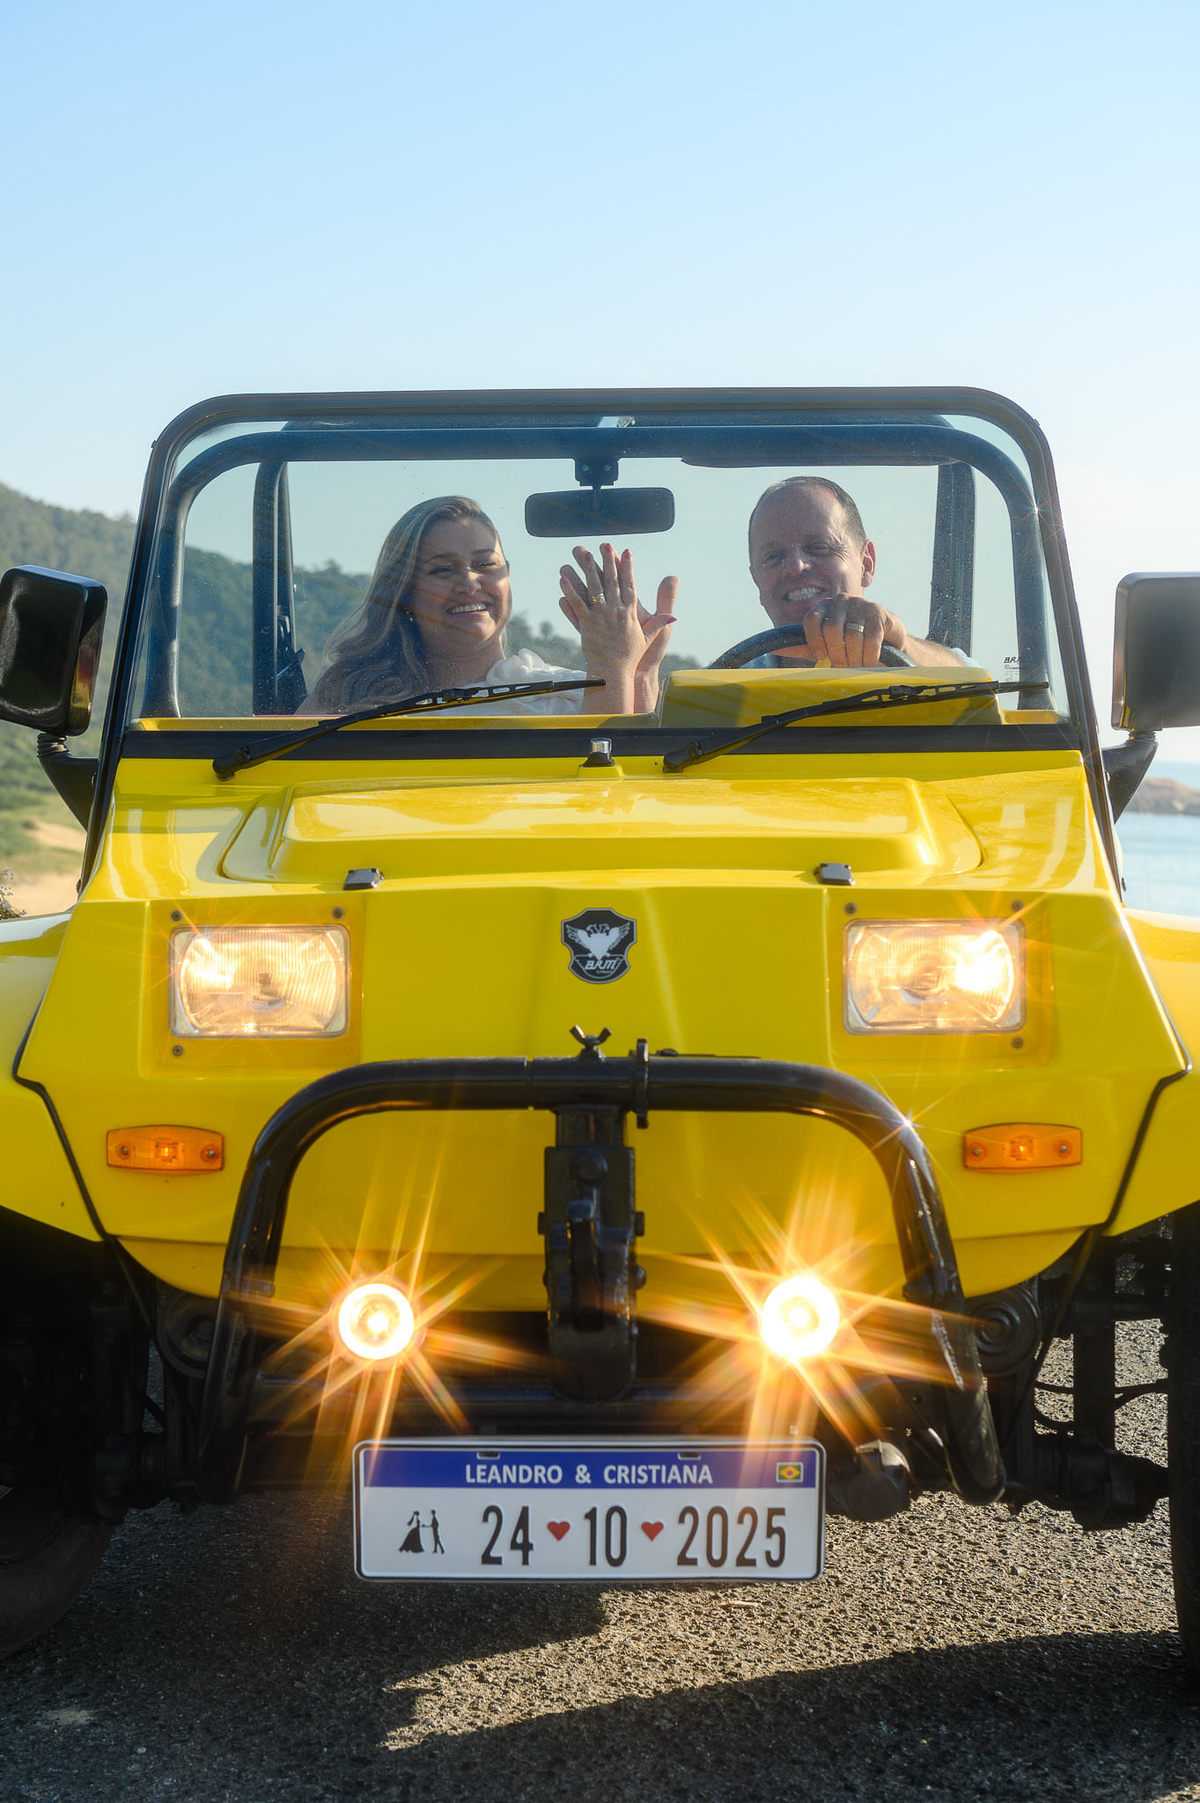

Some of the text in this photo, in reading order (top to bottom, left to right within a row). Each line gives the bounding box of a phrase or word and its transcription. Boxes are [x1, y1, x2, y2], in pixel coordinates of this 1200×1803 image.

[465, 1464, 713, 1485] LEANDRO & CRISTIANA
[480, 1505, 787, 1568] 24 10 2025
